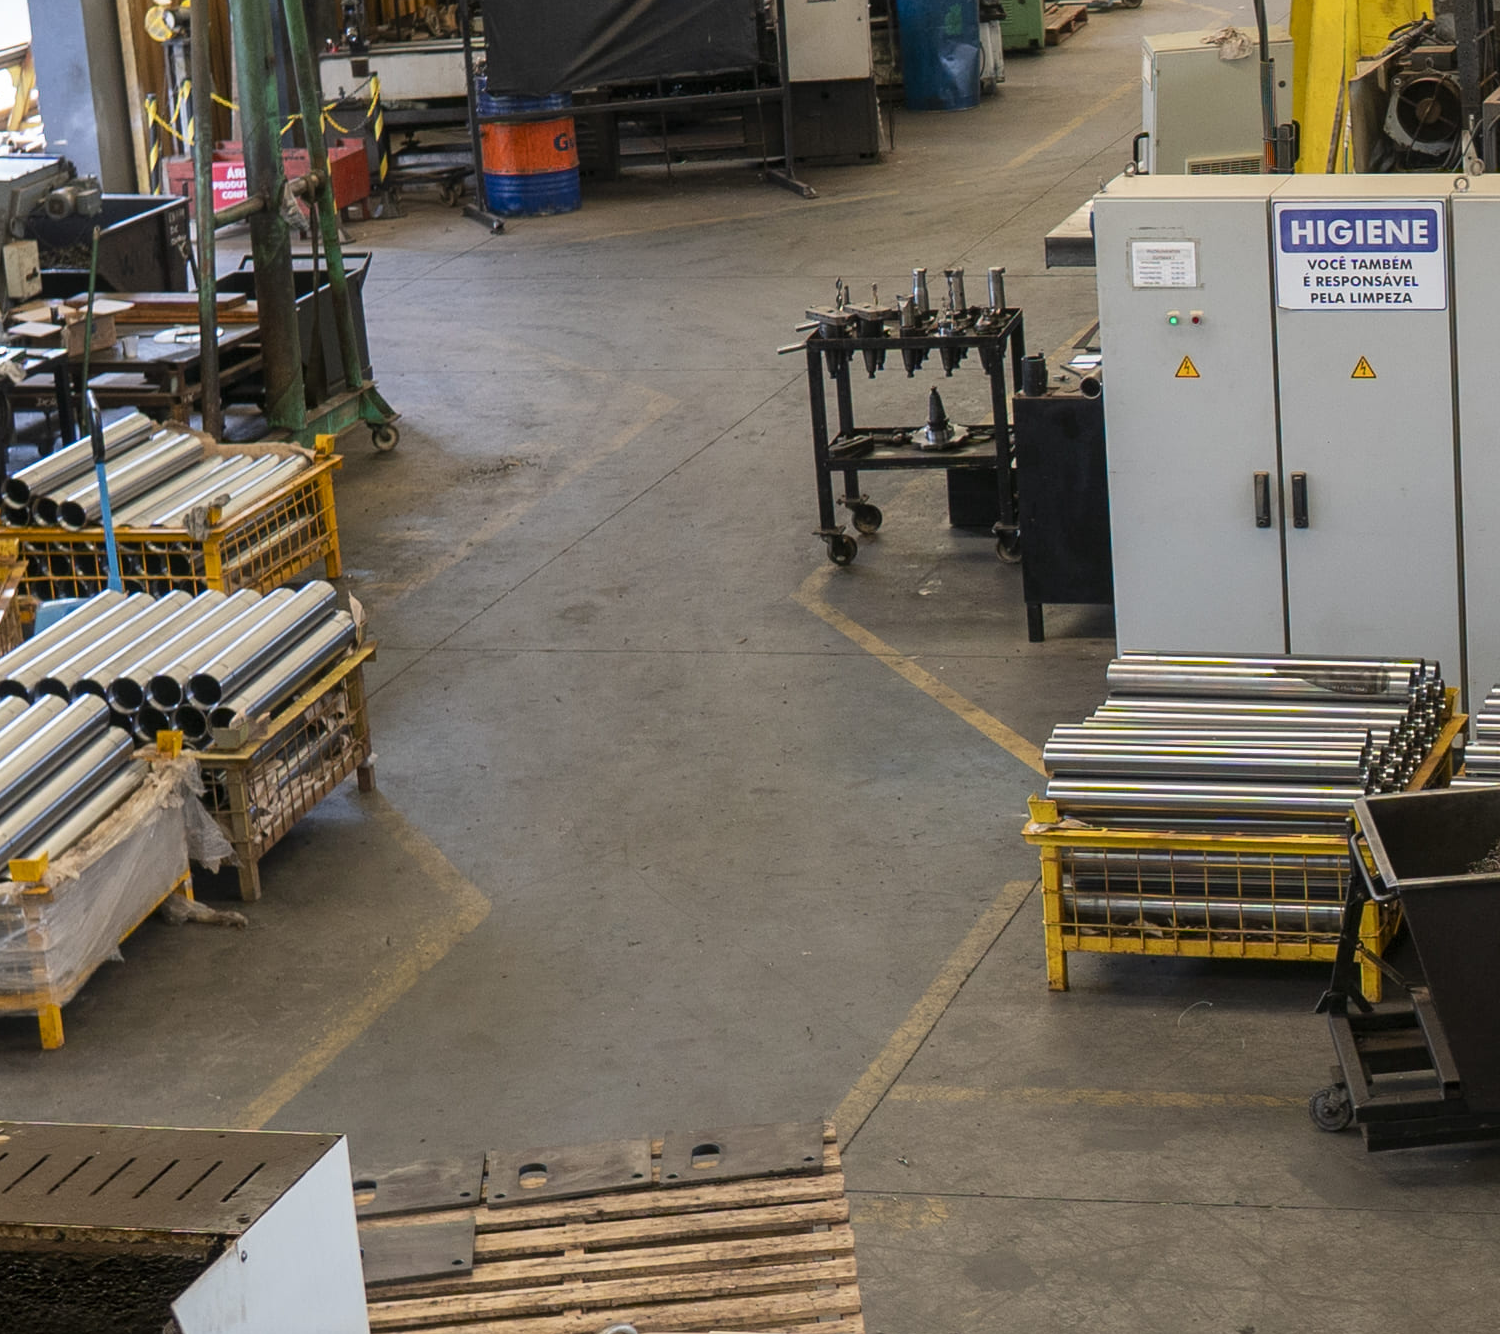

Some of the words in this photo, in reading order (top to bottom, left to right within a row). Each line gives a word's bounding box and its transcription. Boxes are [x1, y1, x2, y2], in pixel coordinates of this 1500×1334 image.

[1291, 219, 1429, 245] HIGIENE
[1307, 256, 1346, 270] VOCÊ
[1350, 256, 1413, 270] TAMBÉM
[1303, 273, 1311, 287] É
[1316, 273, 1419, 287] RESPONSÁVEL
[1310, 292, 1345, 304] PELA
[1350, 292, 1413, 304] LIMPEZA
